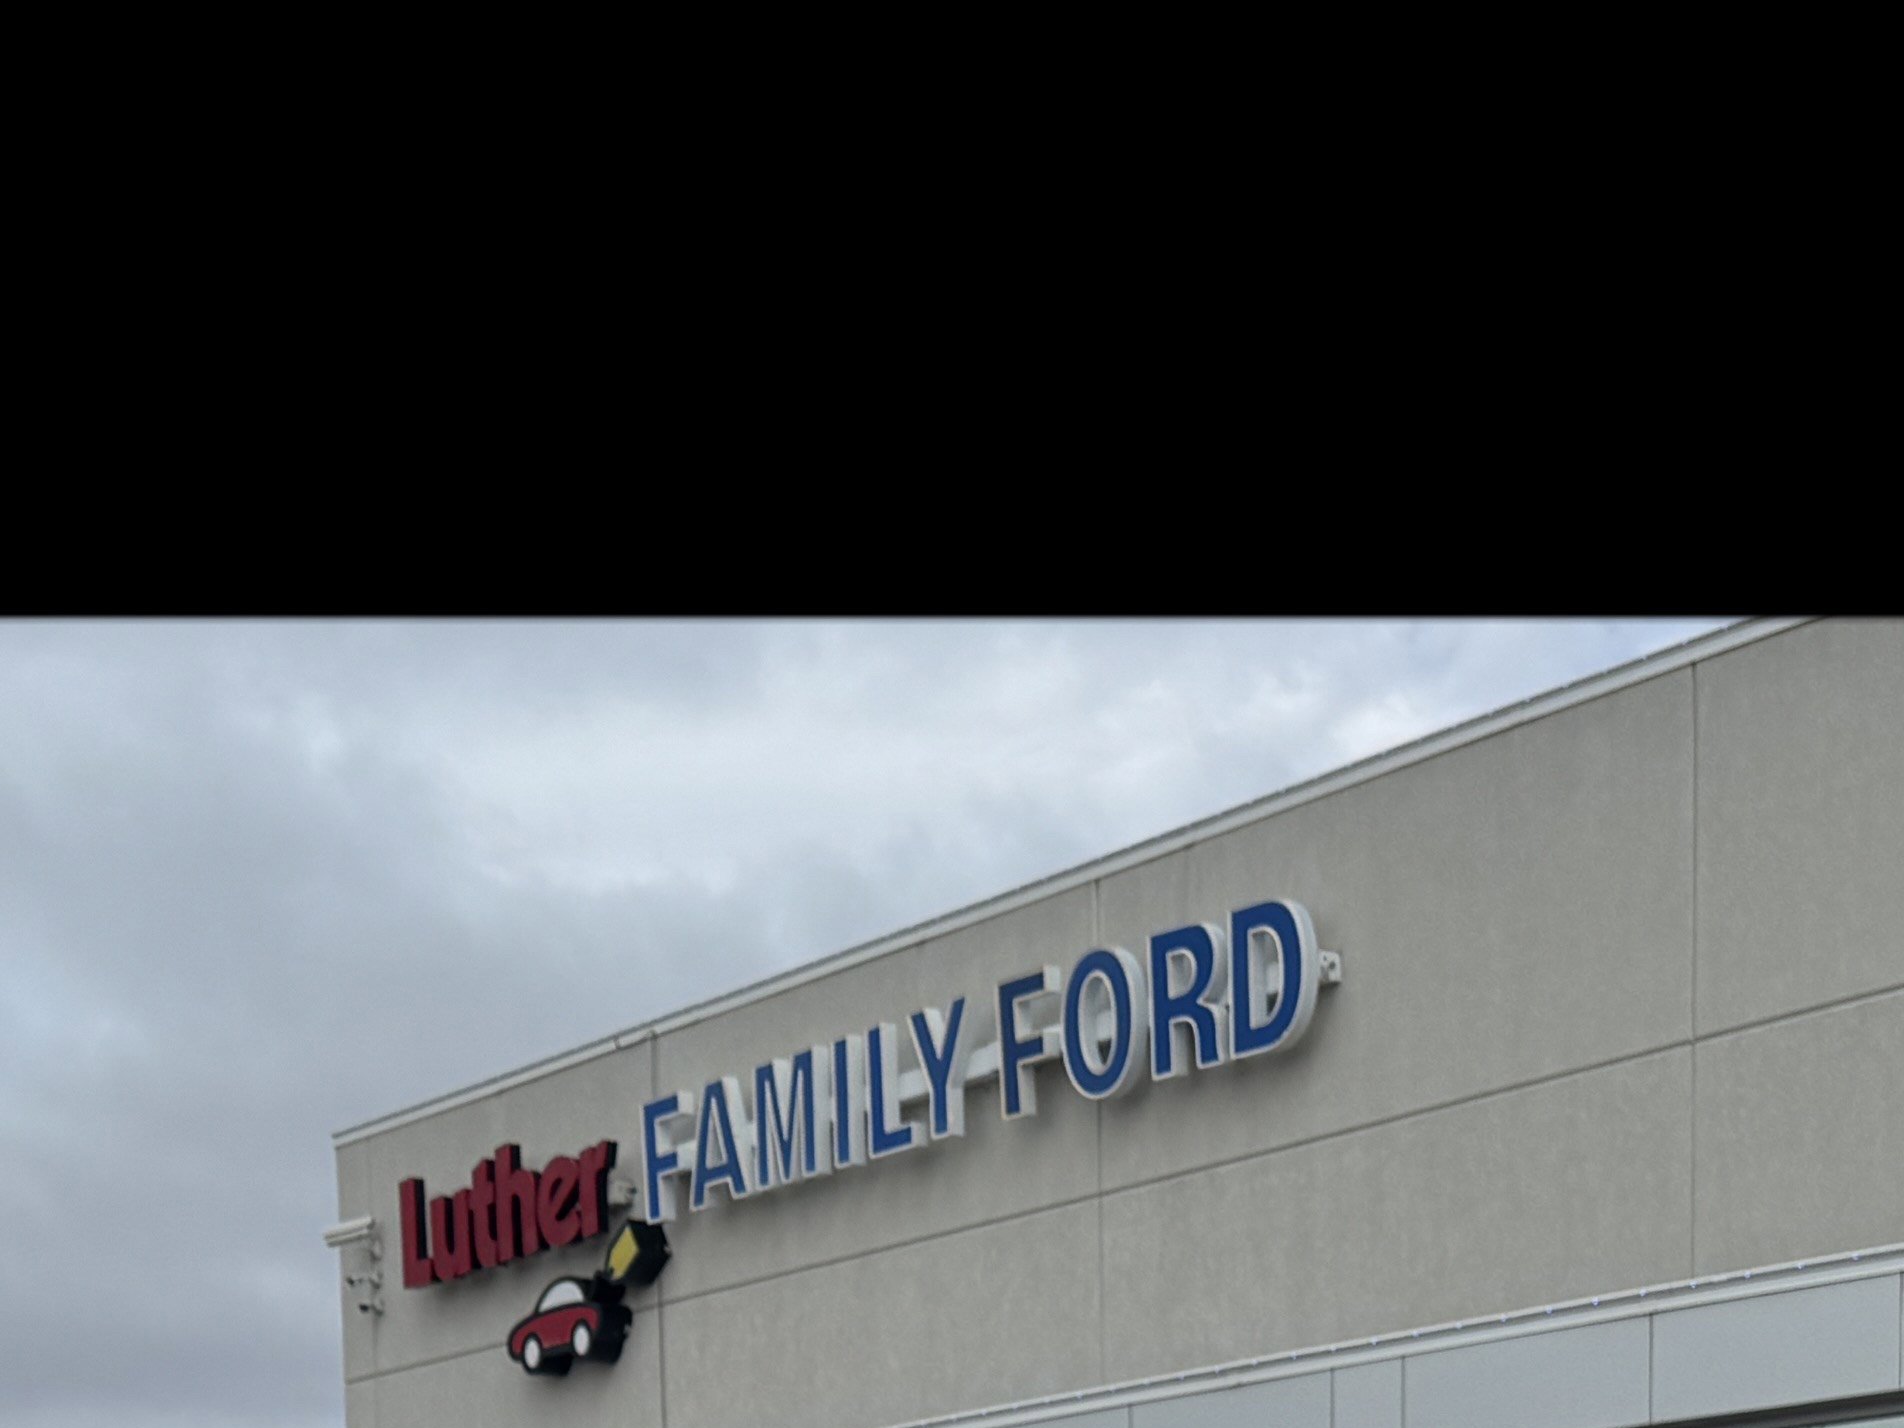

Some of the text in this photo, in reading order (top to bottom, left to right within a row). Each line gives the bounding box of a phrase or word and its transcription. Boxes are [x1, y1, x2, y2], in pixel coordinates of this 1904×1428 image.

[641, 898, 1316, 1226] FAMILY FORD
[398, 1140, 618, 1290] Luther
